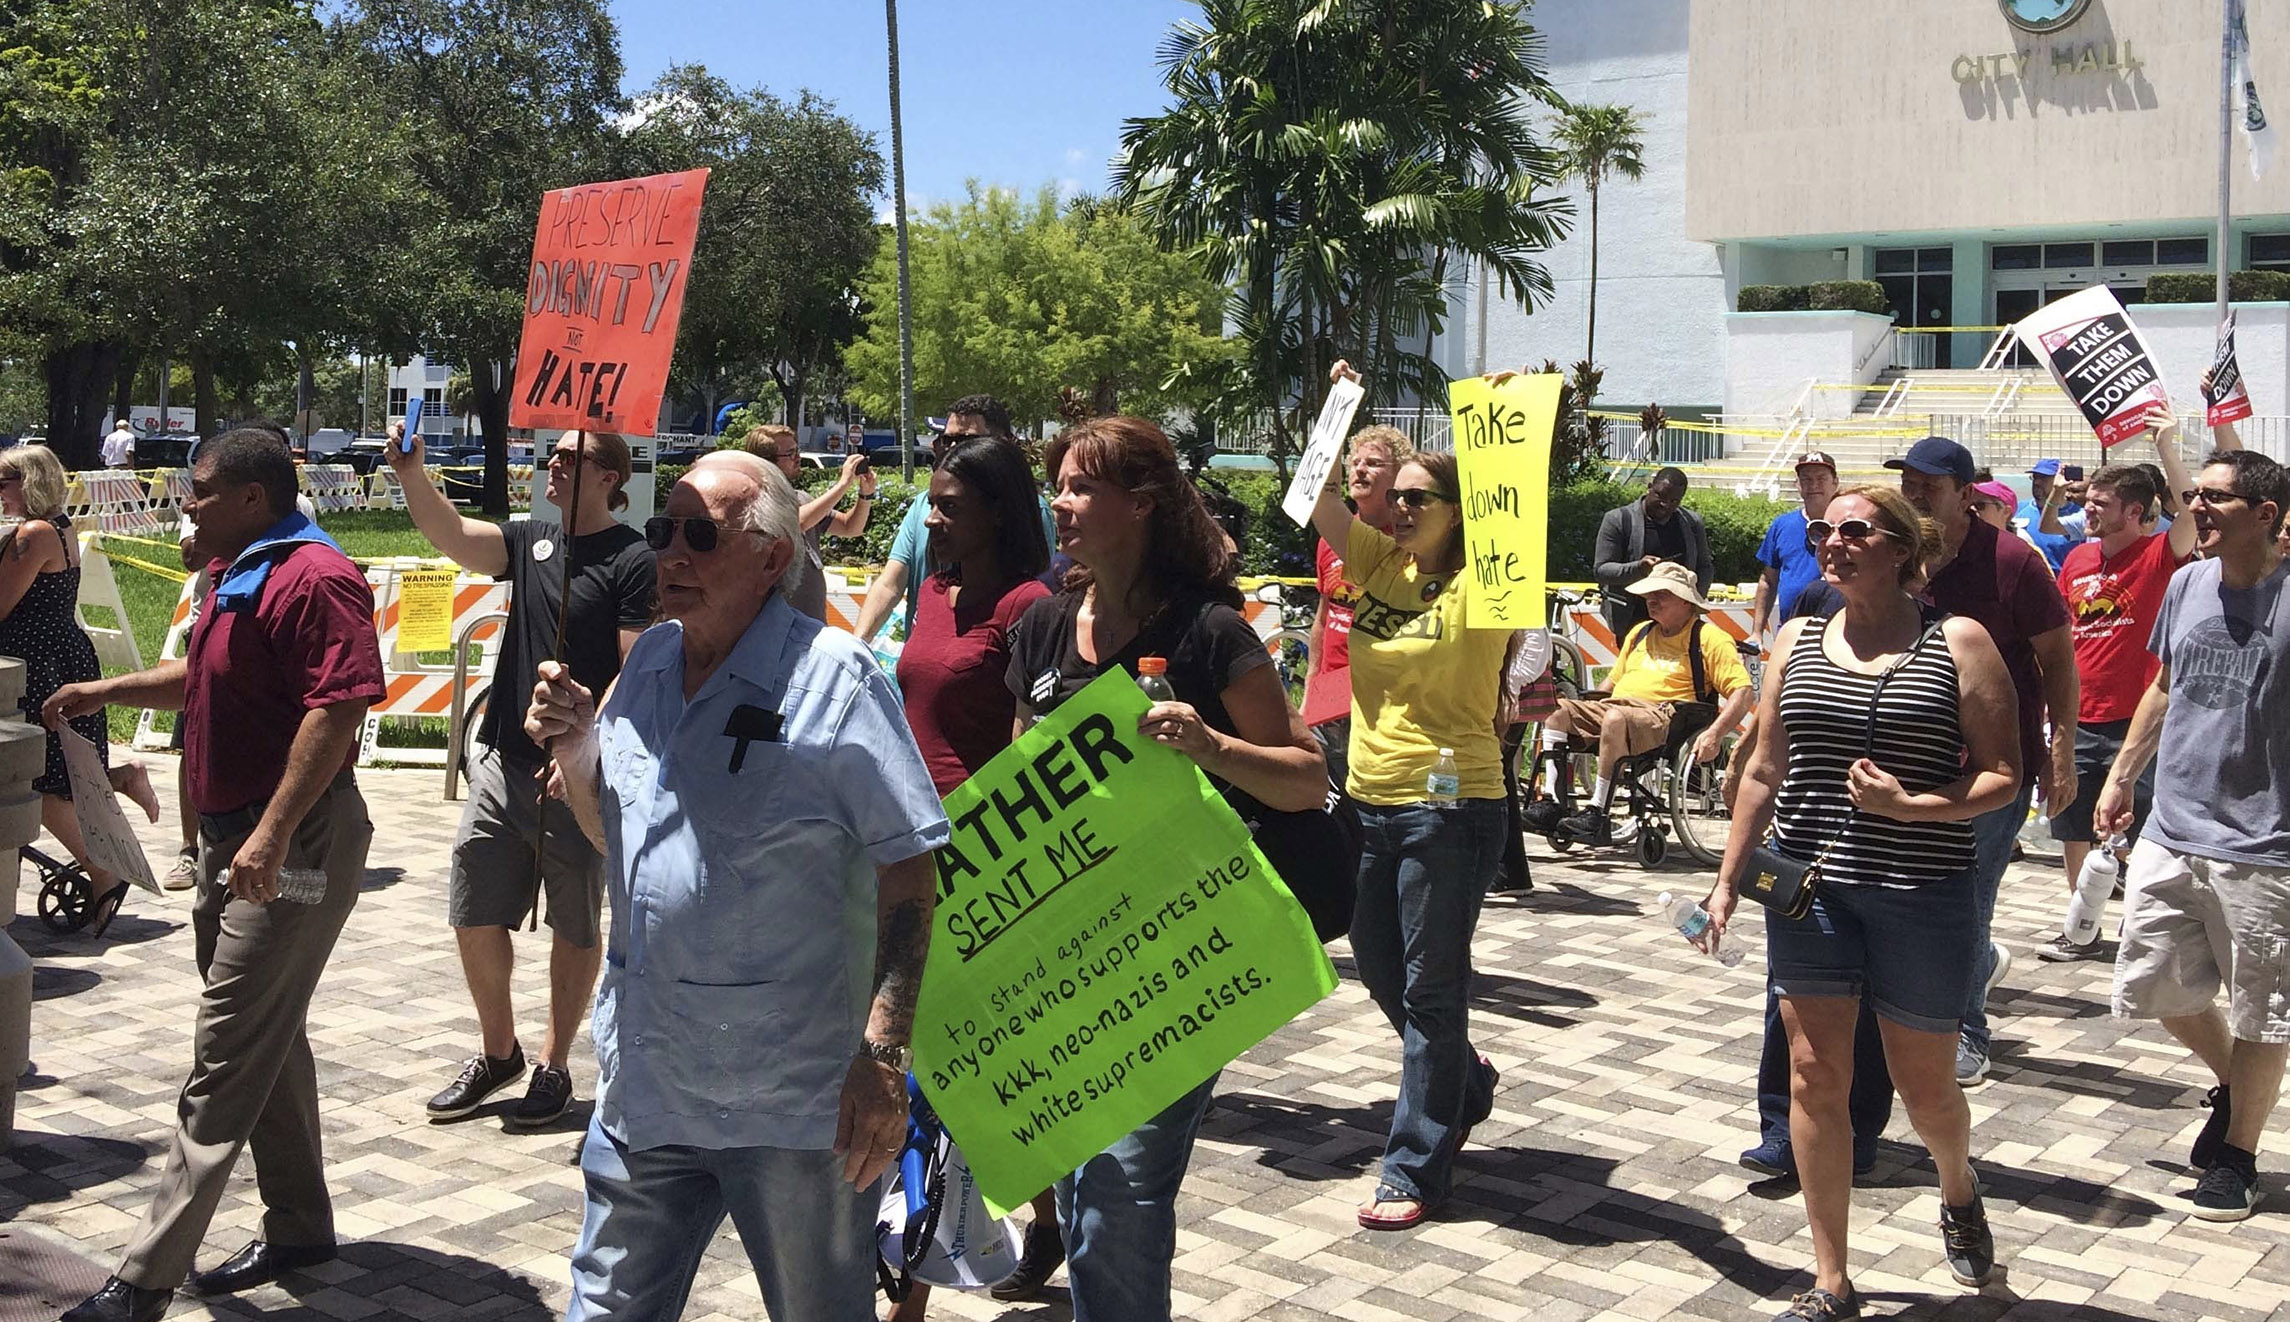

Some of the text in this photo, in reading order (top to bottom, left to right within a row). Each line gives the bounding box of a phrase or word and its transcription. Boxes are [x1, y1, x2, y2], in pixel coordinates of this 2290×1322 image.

[1951, 40, 2144, 84] CITY HALL
[548, 184, 682, 249] PRESERVE
[528, 258, 680, 334] DIGNITY
[2066, 322, 2115, 356] TAKE
[2078, 343, 2133, 384] THEM
[2213, 340, 2231, 374] THEM
[525, 348, 628, 423] HATE!
[2090, 365, 2151, 415] DOWN
[2213, 363, 2237, 401] DOWN
[657, 434, 697, 444] ERCHANT
[1457, 402, 1526, 451] Take
[1466, 471, 1519, 523] down
[402, 575, 453, 583] WARNING
[1472, 538, 1526, 590] hate
[935, 713, 1134, 907] ATHER
[1044, 818, 1110, 883] ME
[1197, 854, 1251, 900] the
[947, 857, 1039, 956] SENT
[944, 1019, 976, 1045] to
[1058, 892, 1133, 960] against
[1049, 967, 1168, 1060] neo-nazis
[1173, 926, 1233, 980] and
